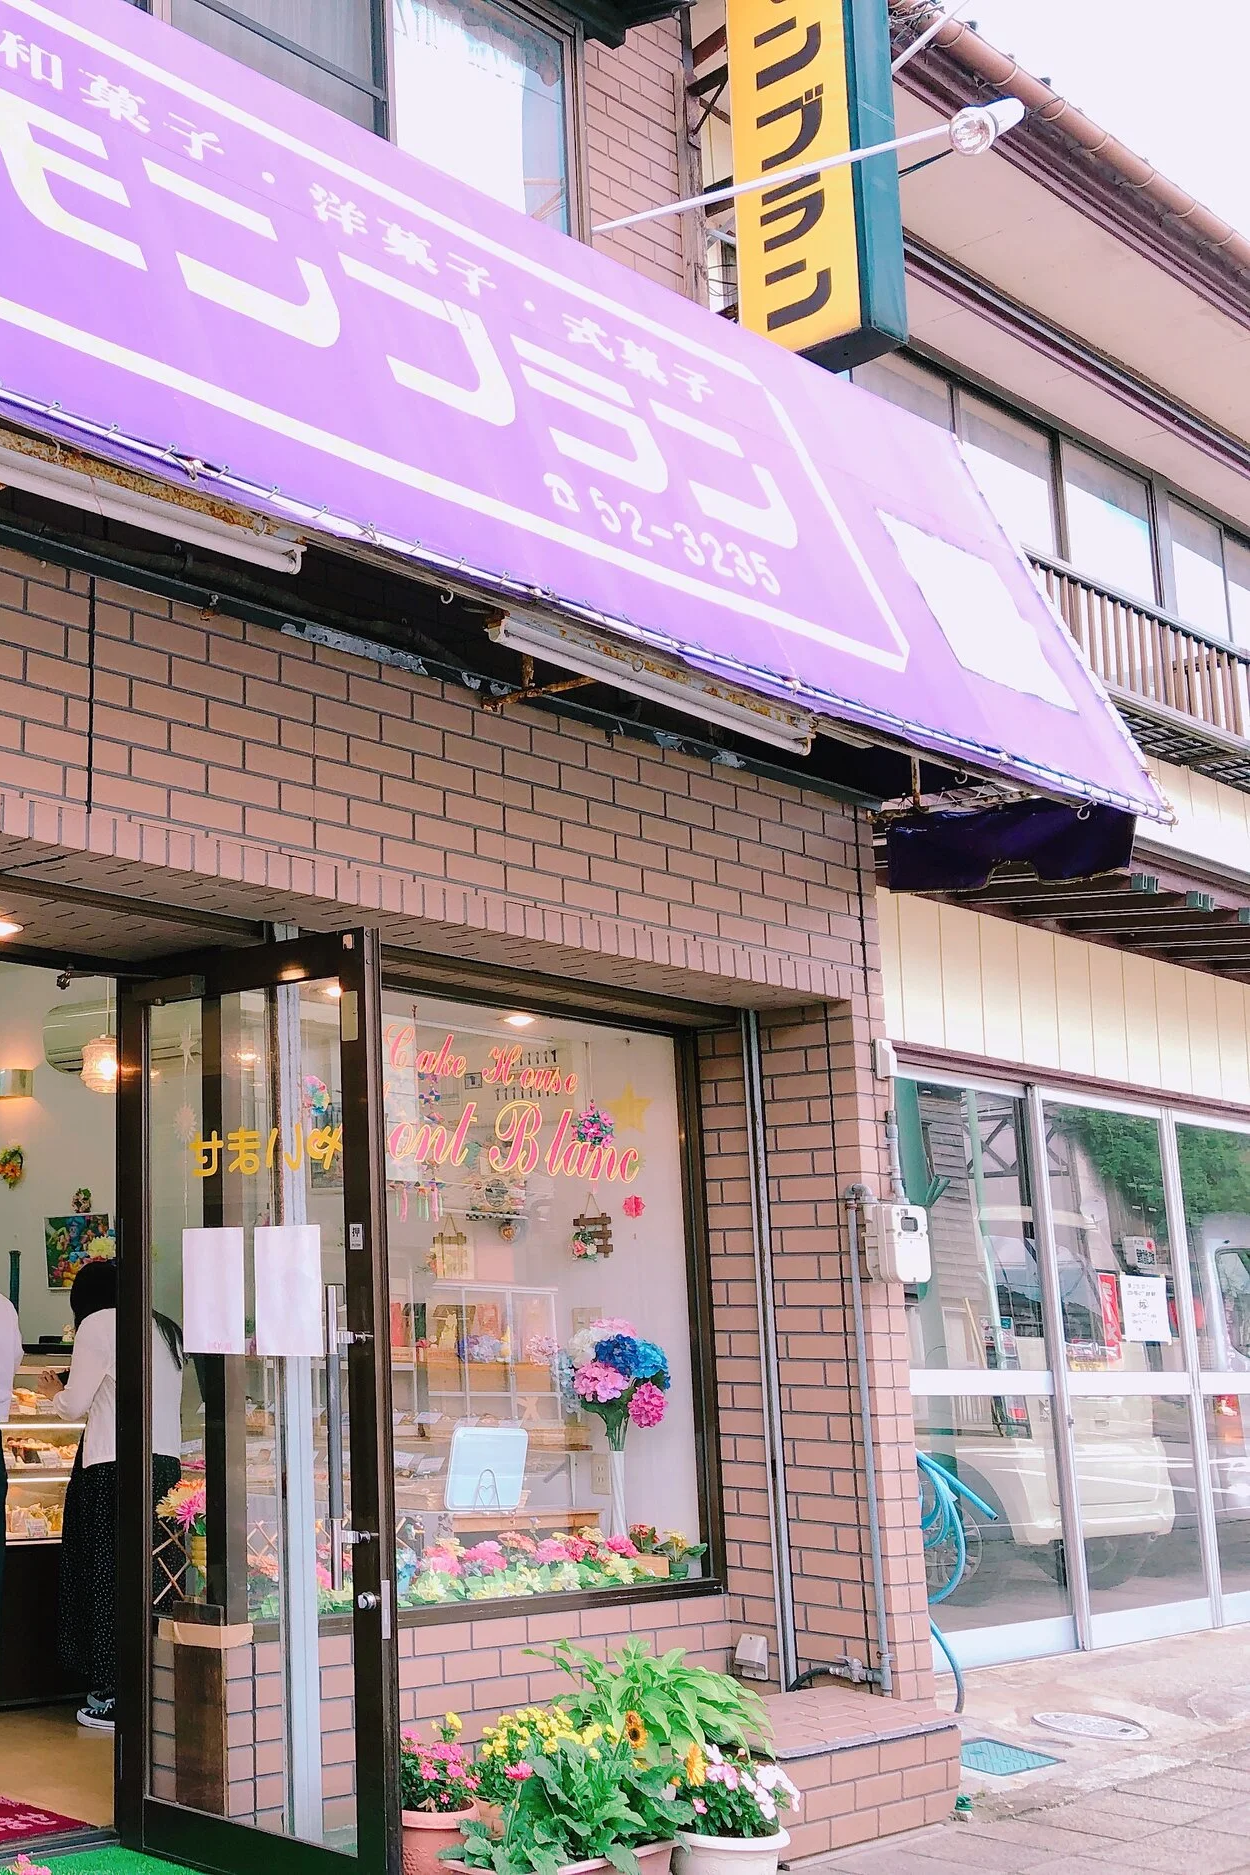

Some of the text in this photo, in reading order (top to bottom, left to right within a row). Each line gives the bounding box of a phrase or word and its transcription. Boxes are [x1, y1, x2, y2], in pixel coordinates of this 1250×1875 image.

[753, 0, 832, 332] ンブラン
[593, 486, 781, 596] 52-3235
[384, 1023, 579, 1096] Cake House
[385, 1100, 640, 1184] ont Blanc
